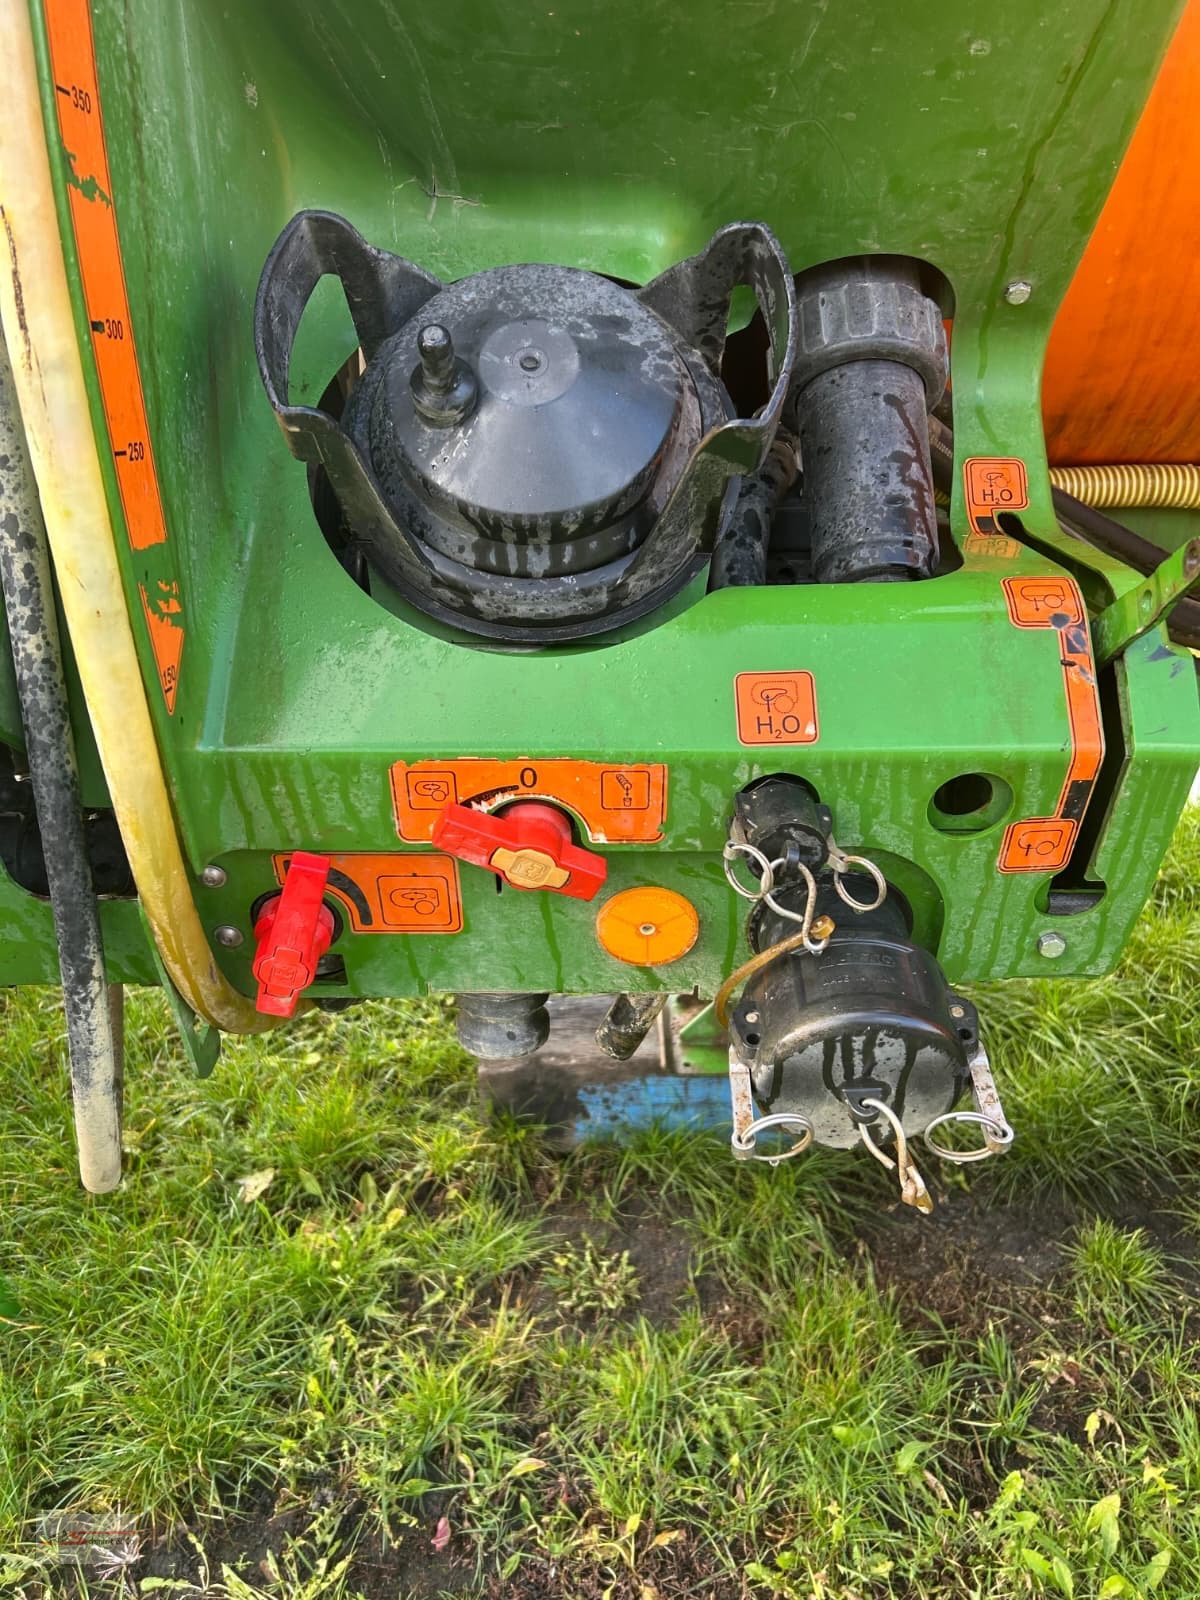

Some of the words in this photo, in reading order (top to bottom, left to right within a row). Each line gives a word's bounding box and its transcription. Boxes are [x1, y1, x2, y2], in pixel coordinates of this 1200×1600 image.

[71, 85, 91, 115] 350
[105, 318, 124, 341] 300
[127, 441, 145, 462] 250
[982, 488, 1013, 504] H2O
[163, 664, 176, 687] 150
[756, 714, 801, 739] H2O
